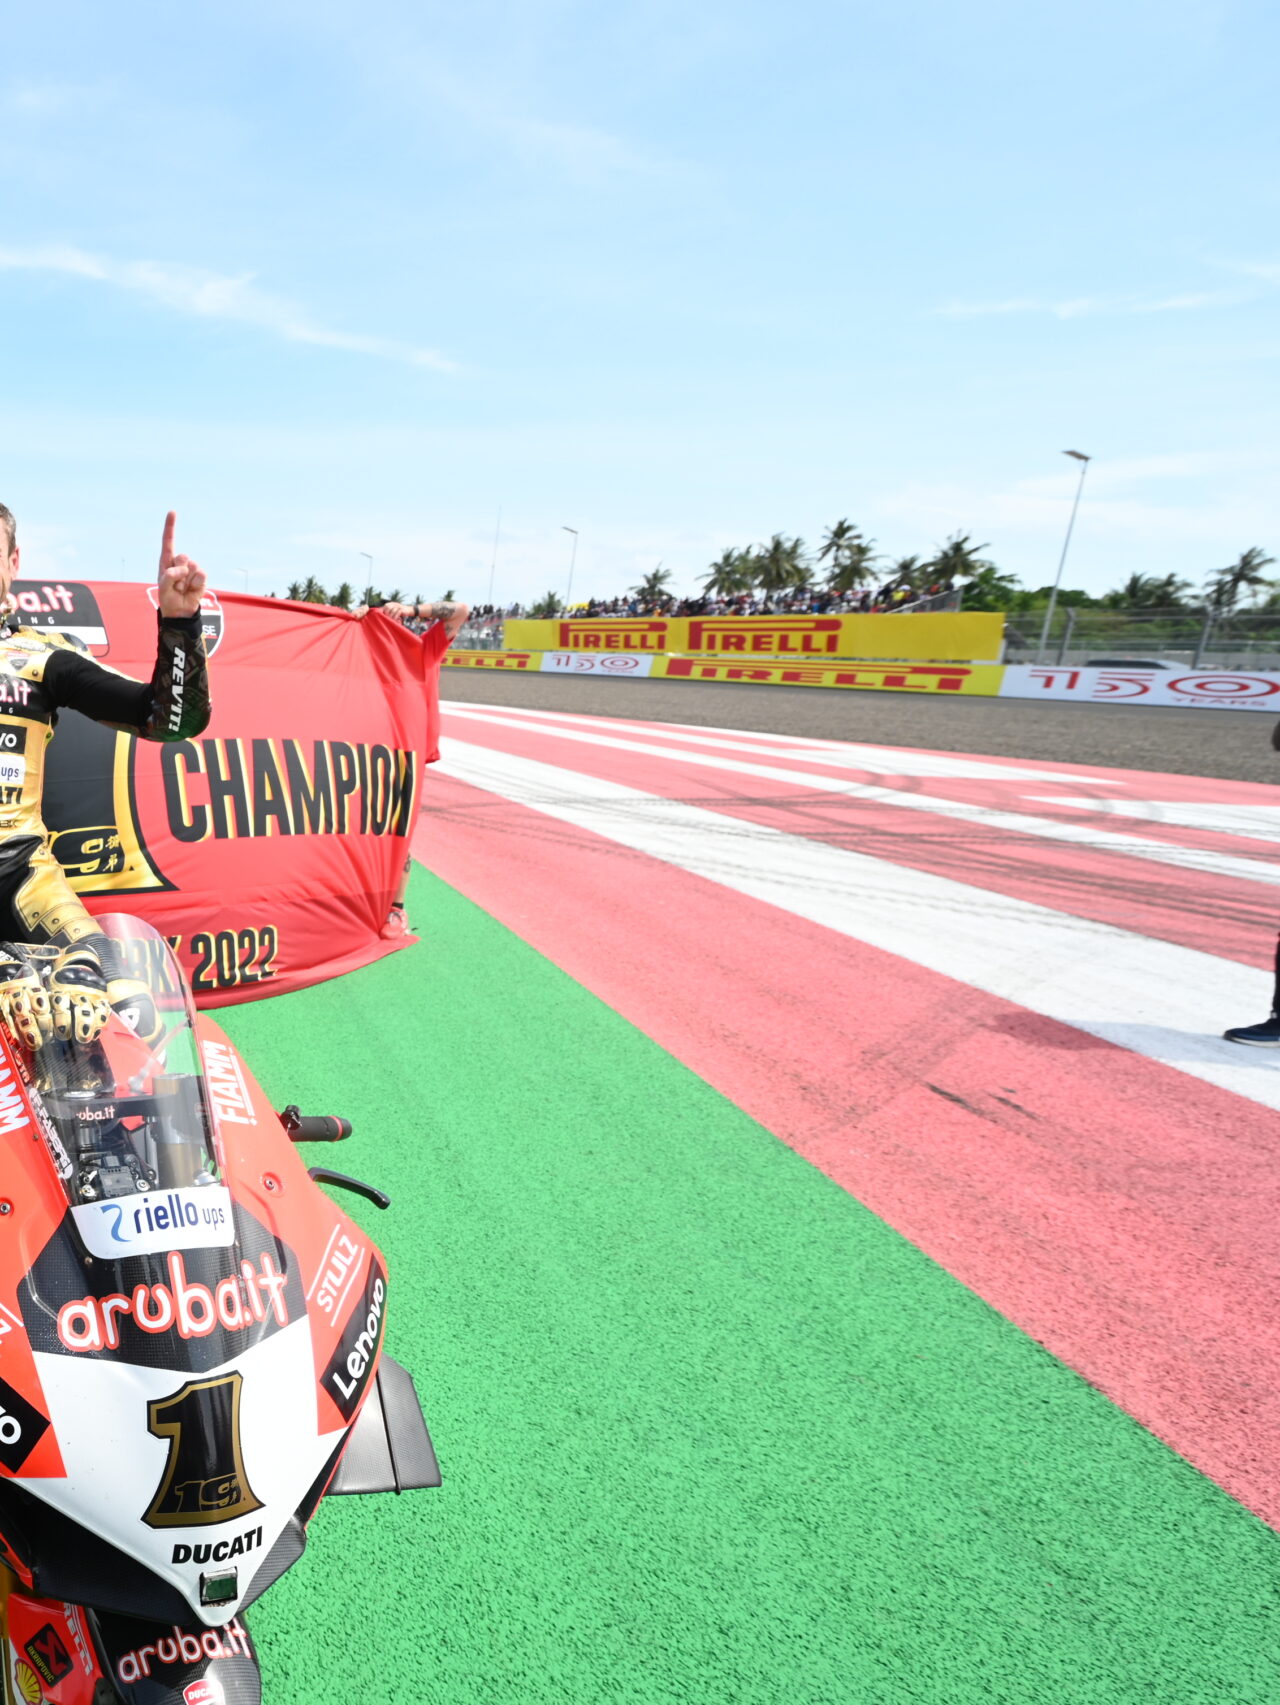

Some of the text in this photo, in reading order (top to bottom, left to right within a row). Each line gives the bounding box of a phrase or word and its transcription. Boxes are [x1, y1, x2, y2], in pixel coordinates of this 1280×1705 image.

[559, 621, 668, 649] PIRELLI
[688, 619, 843, 653] PIRELLI
[168, 646, 187, 732] REV'IT!
[666, 658, 973, 691] PIRELLI
[1, 766, 20, 780] ups
[160, 737, 417, 843] CHAMPION
[190, 924, 279, 991] 2022
[202, 1039, 246, 1126] FIAMM
[134, 1192, 225, 1234] riello ups
[57, 1252, 288, 1350] aruba.it
[317, 1234, 359, 1313] STULZ
[332, 1277, 385, 1400] Lenovo
[140, 1369, 267, 1530] 1
[171, 1525, 263, 1565] DUCATI
[120, 1616, 252, 1685] aruba.it
